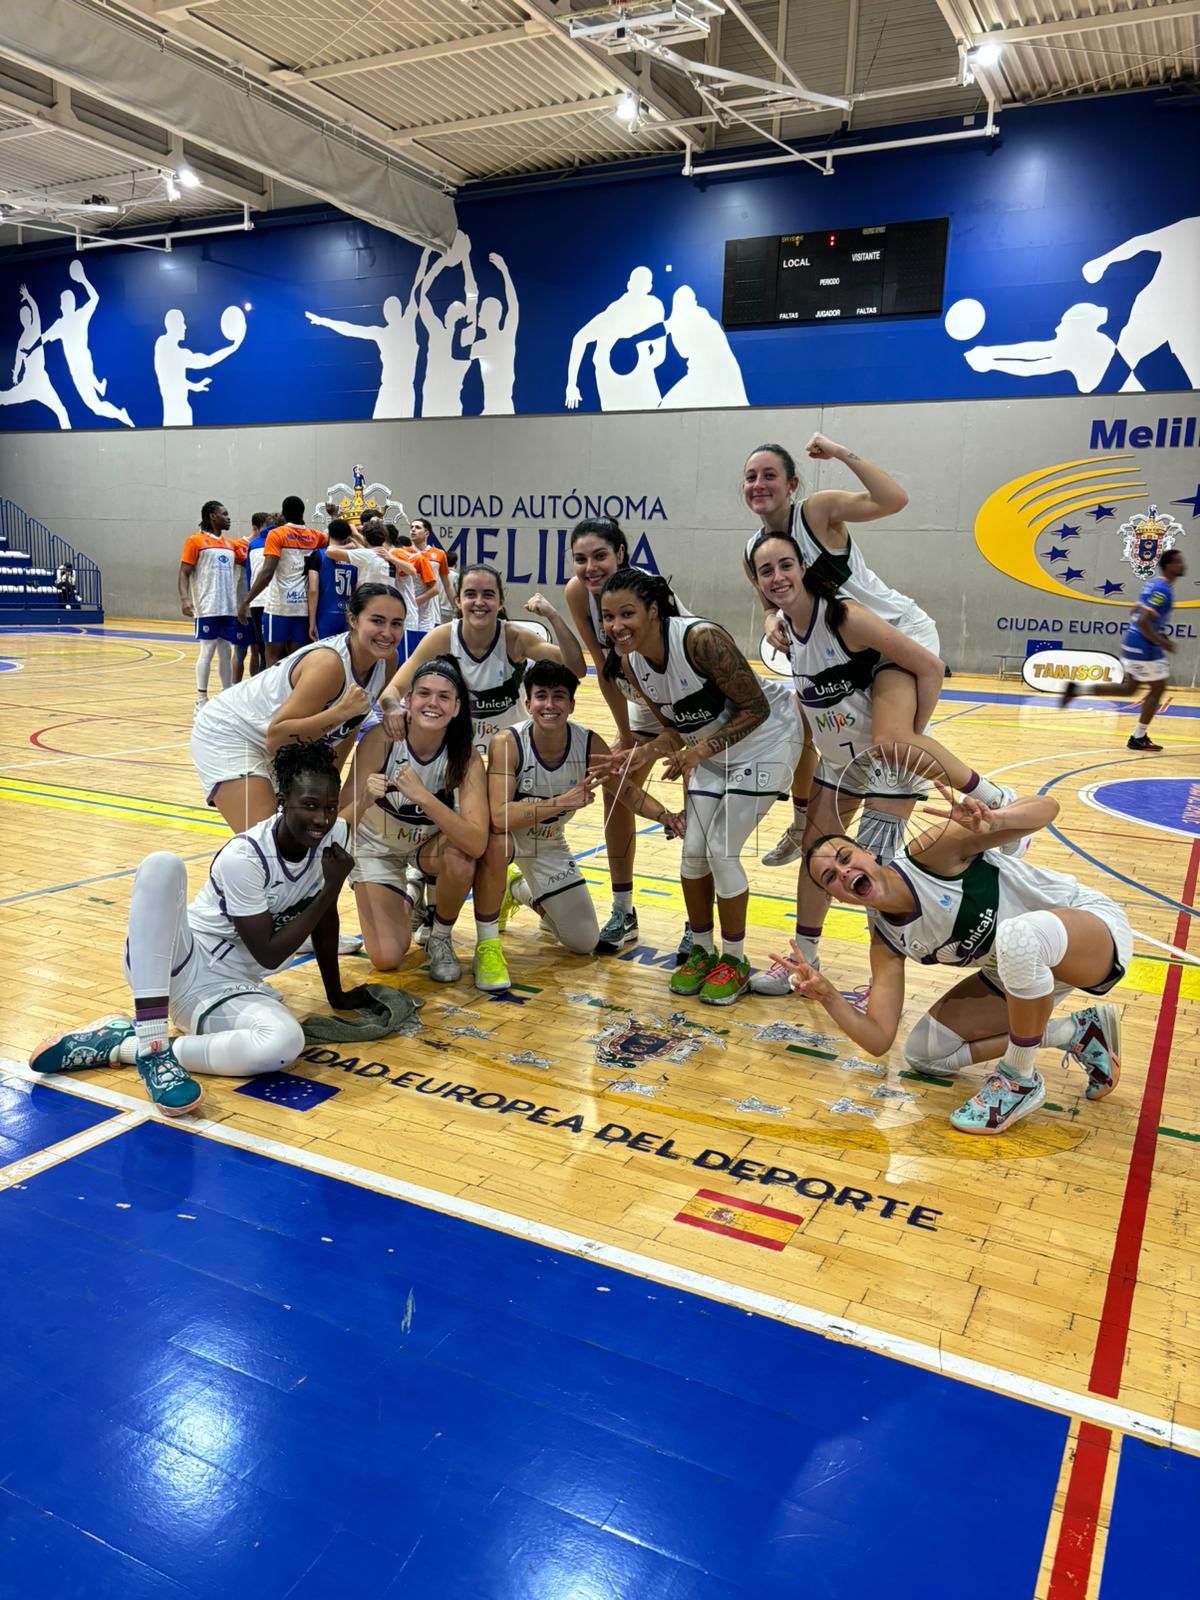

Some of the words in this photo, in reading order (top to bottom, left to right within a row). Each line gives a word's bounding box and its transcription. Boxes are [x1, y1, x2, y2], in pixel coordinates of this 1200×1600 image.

[783, 258, 811, 268] LOCAL
[852, 250, 881, 262] VISITANTE
[819, 277, 840, 286] PERIODO
[815, 309, 841, 318] JUGADOR
[857, 307, 877, 315] FALTAS
[1089, 416, 1200, 449] Melil
[418, 494, 503, 518] CIUDAD
[512, 488, 668, 521] AUTÓNOMA
[439, 526, 454, 539] DE
[427, 527, 661, 585] MELILA
[334, 567, 353, 597] 51
[997, 617, 1063, 633] CIUDAD
[1069, 620, 1130, 636] EUROP
[815, 679, 852, 697] Unicaja
[675, 708, 713, 723] Unicaja
[815, 711, 856, 735] Mijas
[397, 827, 434, 845] Mija
[961, 908, 994, 950] Unicaja
[210, 939, 236, 961] 11
[389, 1071, 584, 1132] EUROPEA
[593, 1122, 681, 1160] DEL
[692, 1149, 944, 1232] DEPORTE
